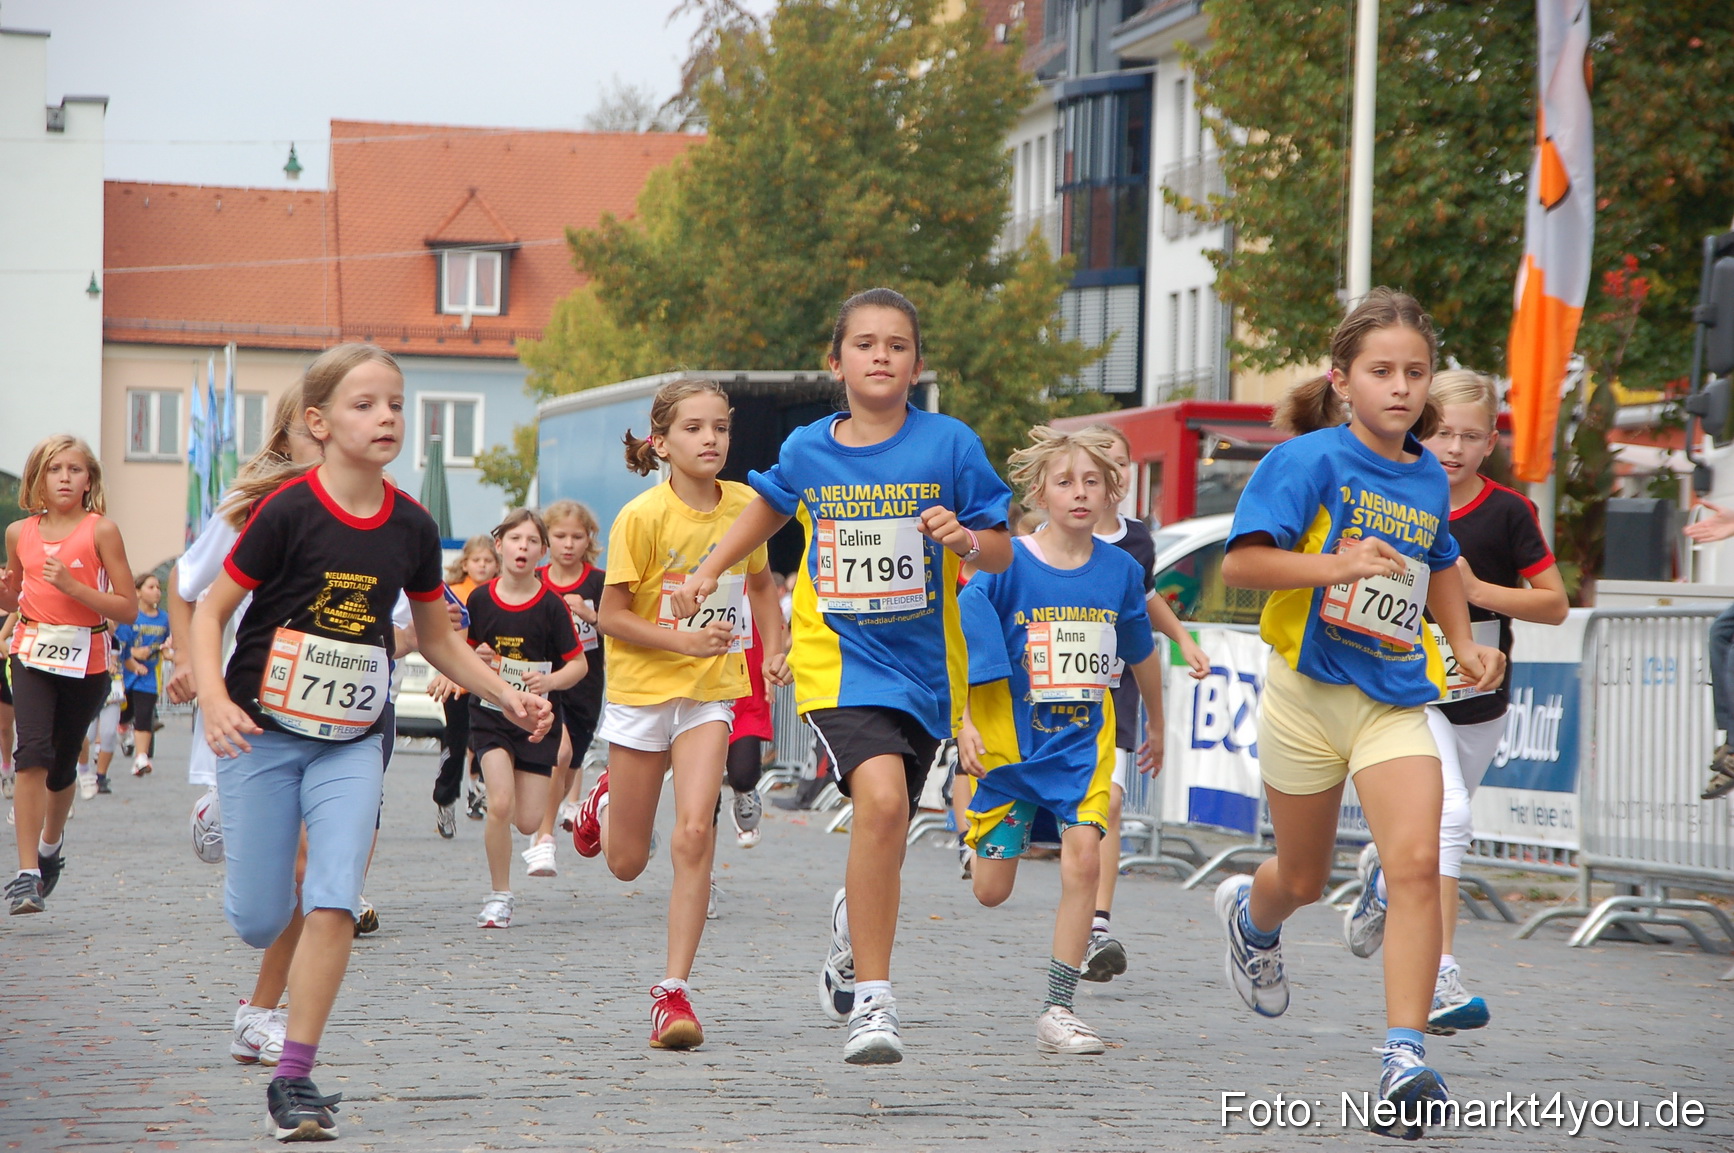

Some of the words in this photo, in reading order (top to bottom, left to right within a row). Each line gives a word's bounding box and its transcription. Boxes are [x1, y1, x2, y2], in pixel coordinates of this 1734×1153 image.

[803, 487, 819, 503] 10.
[821, 483, 941, 502] NEUMARKTER
[819, 500, 917, 518] STADTLAUF
[839, 529, 882, 547] Celine
[820, 555, 831, 569] K5
[842, 555, 914, 583] 7196
[325, 571, 378, 585] NEUMARKTER
[328, 580, 372, 591] STADTLAUF
[882, 594, 924, 606] PFLEIDERER
[1361, 586, 1418, 631] 7022
[1056, 628, 1086, 642] Anna
[36, 643, 82, 662] 7297
[305, 643, 378, 673] Katharina
[1033, 651, 1046, 664] K5
[270, 664, 287, 681] K5
[1058, 652, 1110, 675] 7068
[301, 674, 377, 711] 7132
